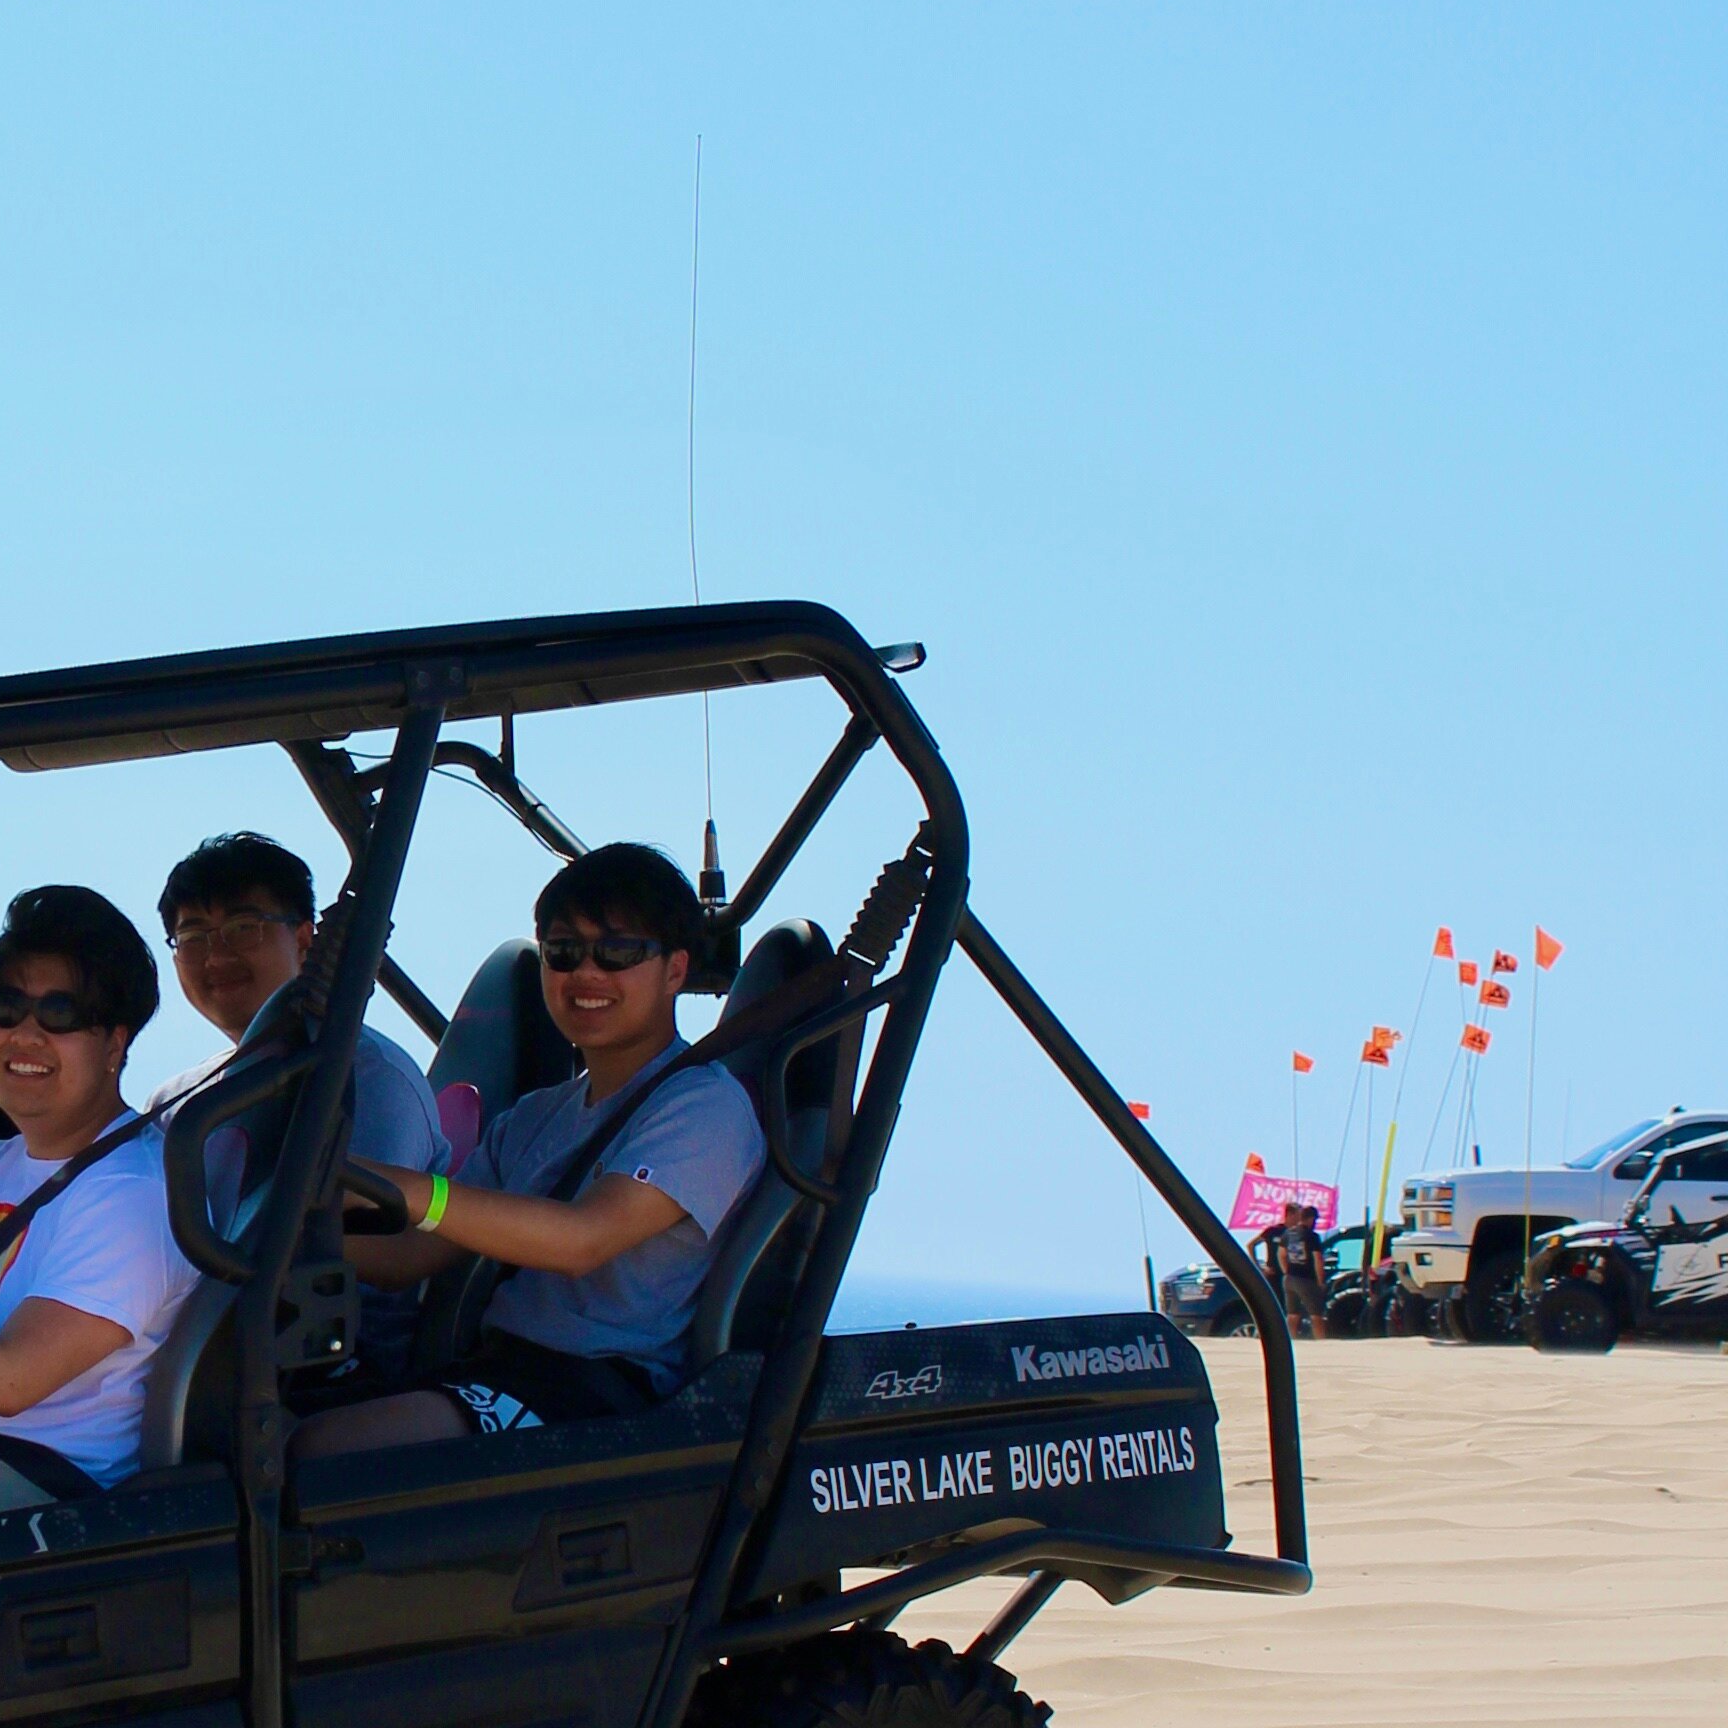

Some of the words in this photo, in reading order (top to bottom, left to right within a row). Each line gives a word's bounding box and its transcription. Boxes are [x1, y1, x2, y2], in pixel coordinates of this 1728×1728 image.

[1252, 1183, 1329, 1207] WOMEN
[1011, 1335, 1170, 1382] Kawasaki
[865, 1365, 942, 1399] 4x4
[811, 1461, 914, 1514] SILVER
[920, 1450, 994, 1501] LAKE
[1009, 1438, 1093, 1491] BUGGY
[1098, 1427, 1196, 1480] RENTALS
